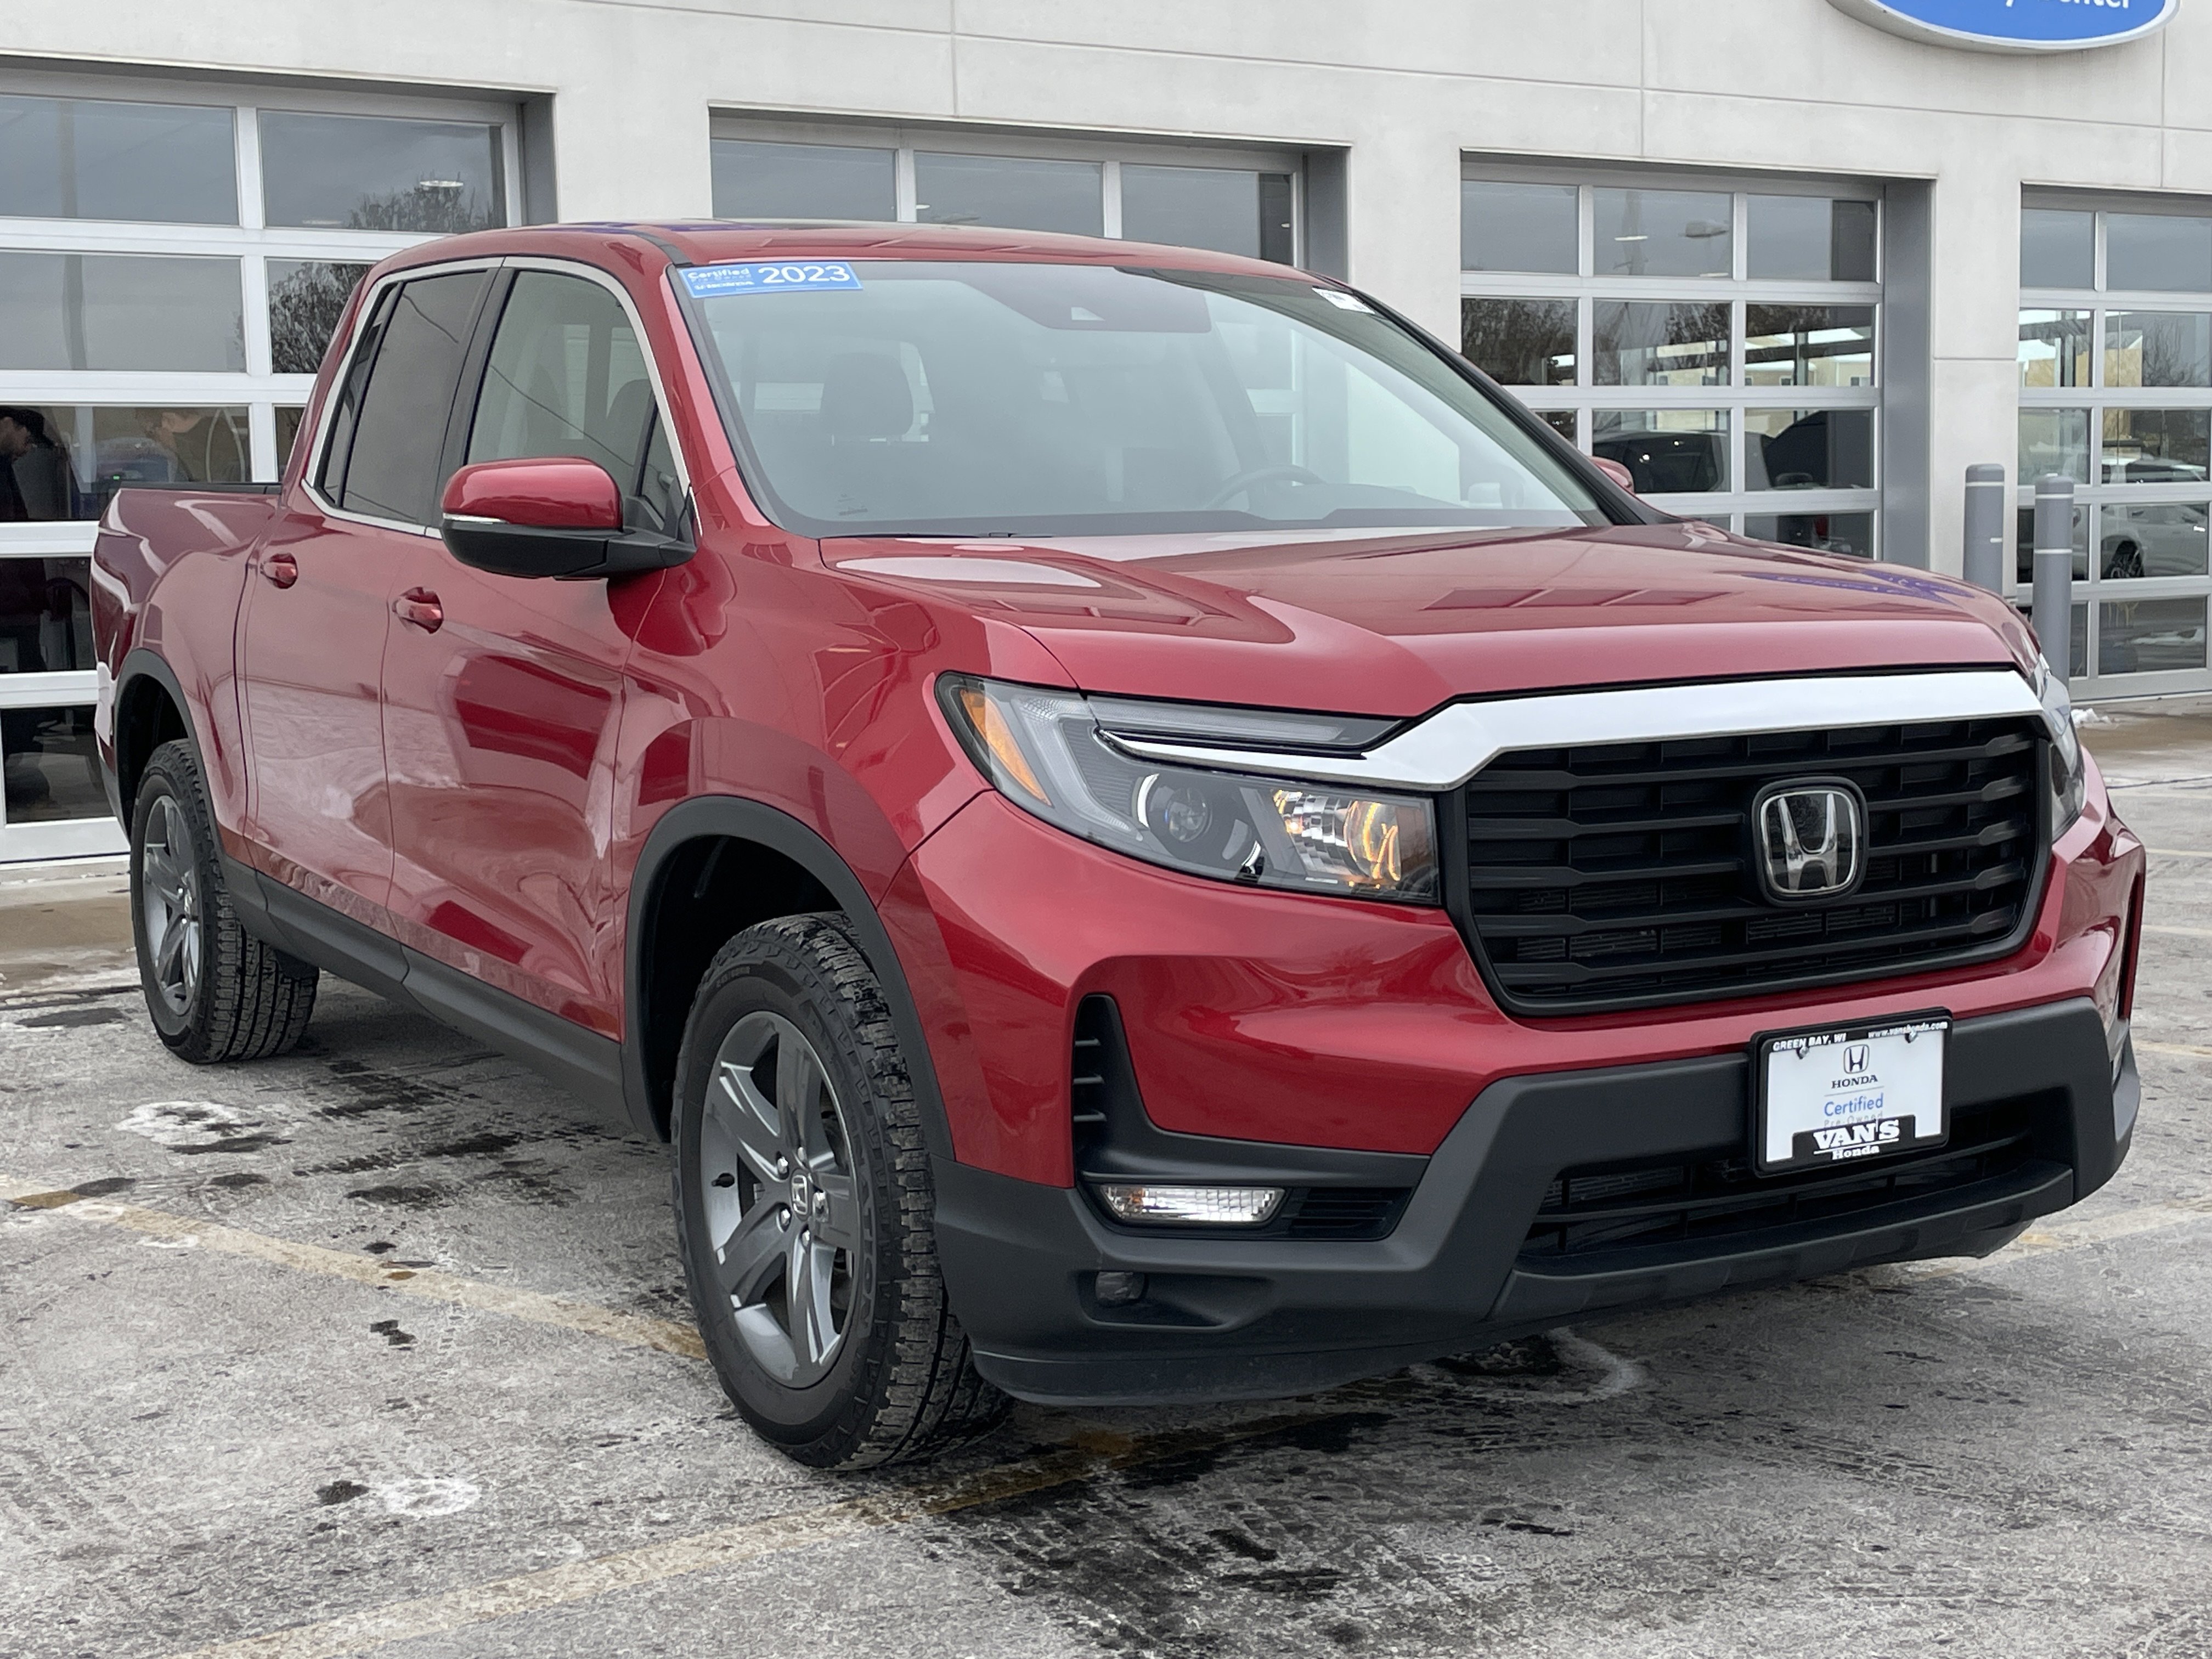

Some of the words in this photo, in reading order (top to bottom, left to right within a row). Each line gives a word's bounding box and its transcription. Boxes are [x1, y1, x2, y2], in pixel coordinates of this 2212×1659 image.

[687, 267, 751, 279] Certified
[758, 265, 850, 284] 2023
[1773, 1037, 1807, 1051] GREEN
[1808, 1035, 1831, 1046] BAY,
[1833, 1032, 1847, 1043] WI
[1831, 1074, 1878, 1089] HONDA
[1824, 1092, 1884, 1117] Certified
[1831, 1144, 1880, 1160] Honda
